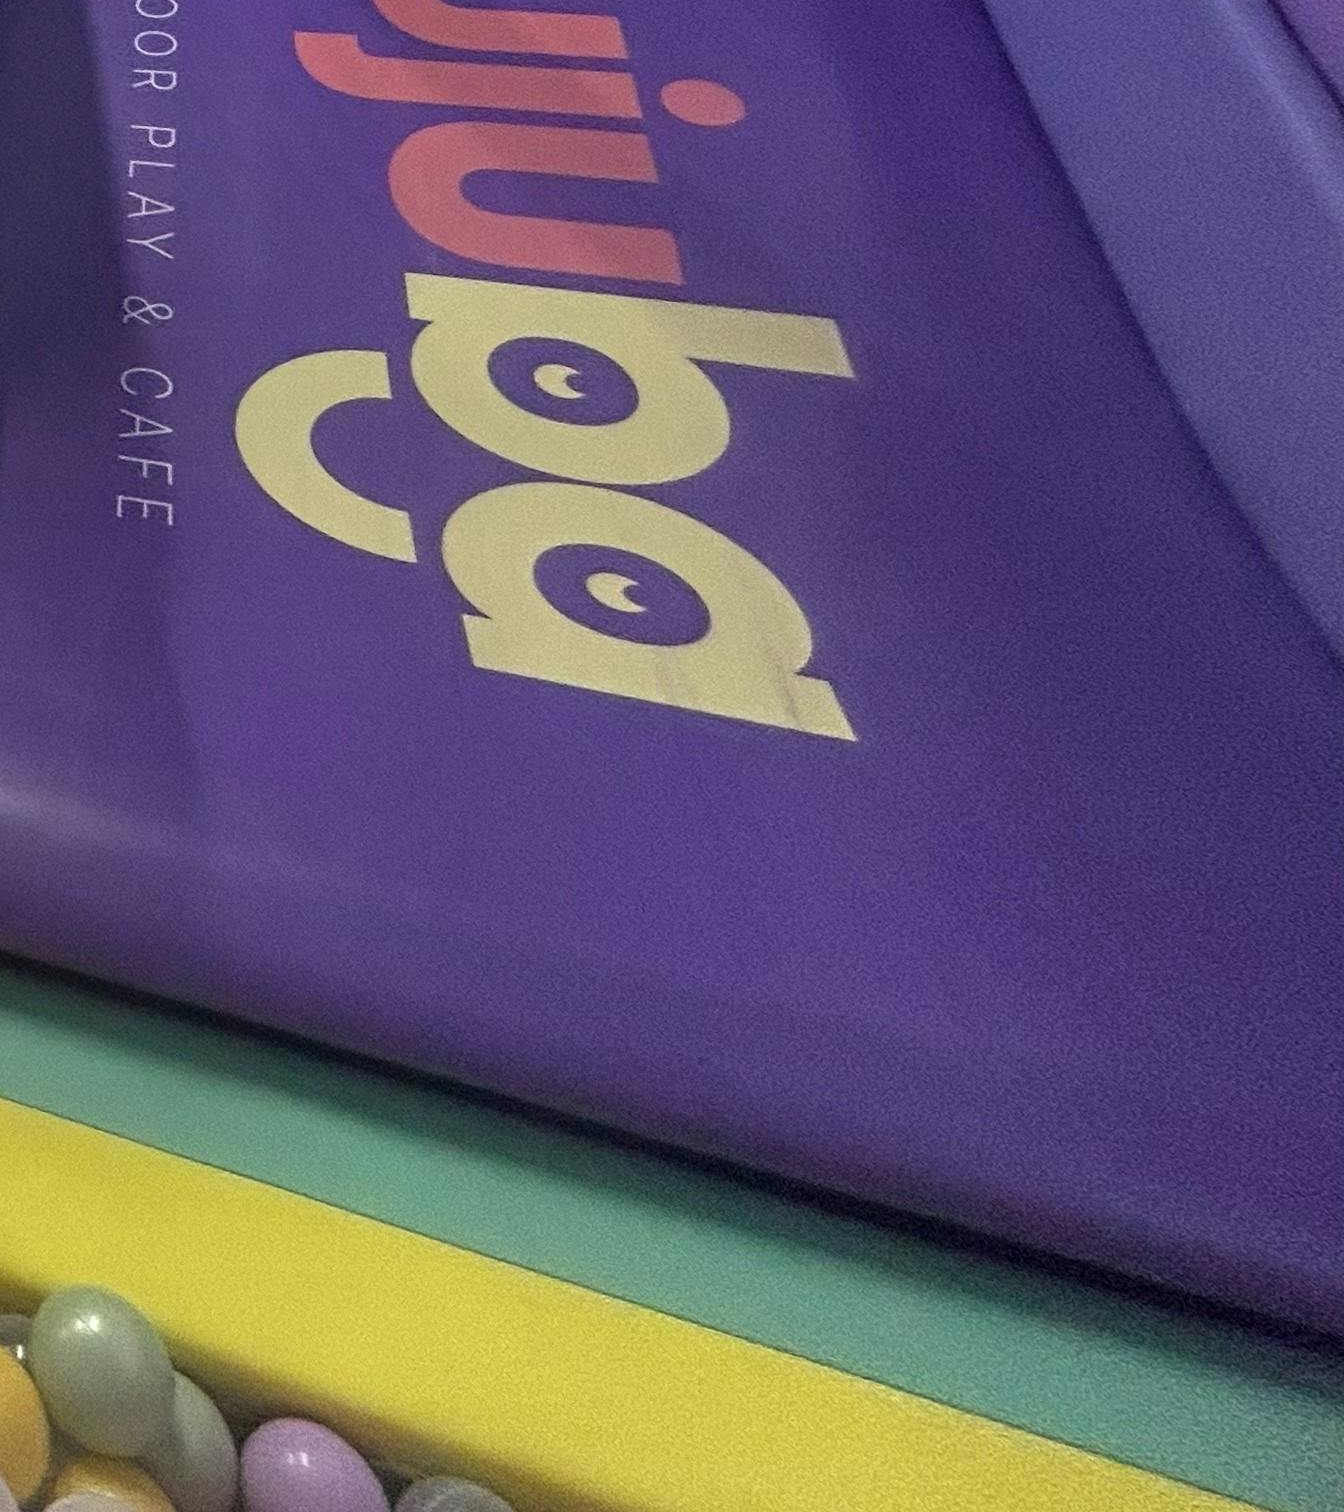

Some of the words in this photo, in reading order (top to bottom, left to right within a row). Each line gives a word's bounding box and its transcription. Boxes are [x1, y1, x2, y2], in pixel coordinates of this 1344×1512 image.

[125, 123, 176, 261] PLAY
[121, 295, 174, 326] &
[115, 366, 174, 527] CAFE
